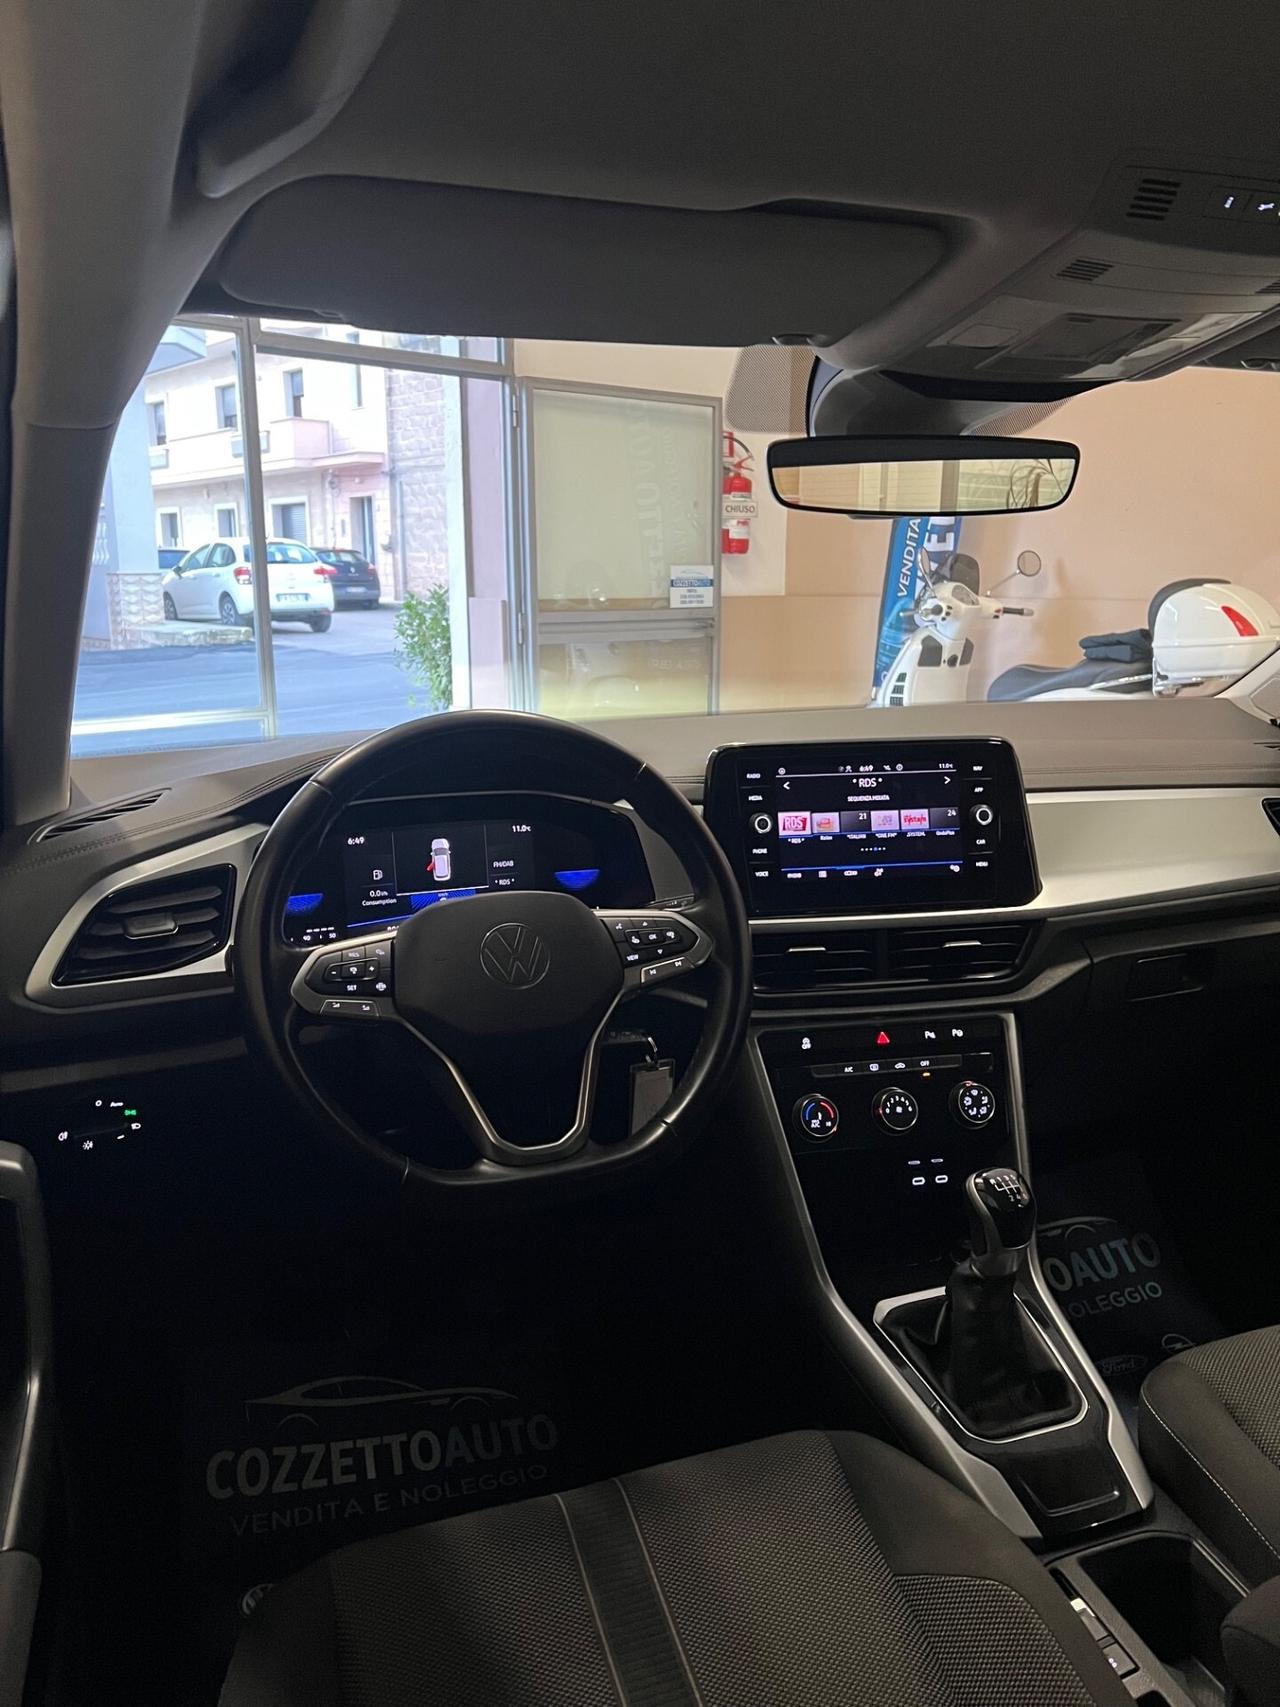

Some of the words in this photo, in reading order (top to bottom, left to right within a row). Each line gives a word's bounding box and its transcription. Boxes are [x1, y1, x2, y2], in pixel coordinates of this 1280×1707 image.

[725, 503, 756, 513] CHIUSO
[897, 518, 921, 597] VENDITA
[858, 777, 877, 787] RDS
[858, 812, 867, 820] 21
[947, 809, 957, 817] 24
[784, 816, 803, 829] RDS
[347, 836, 365, 845] 6:49
[361, 897, 397, 906] Consumption
[206, 1413, 559, 1500] COZZETTOAUTO
[229, 1498, 364, 1536] VENDITA
[374, 1492, 392, 1513] E
[401, 1464, 549, 1508] NOLEGGIO
